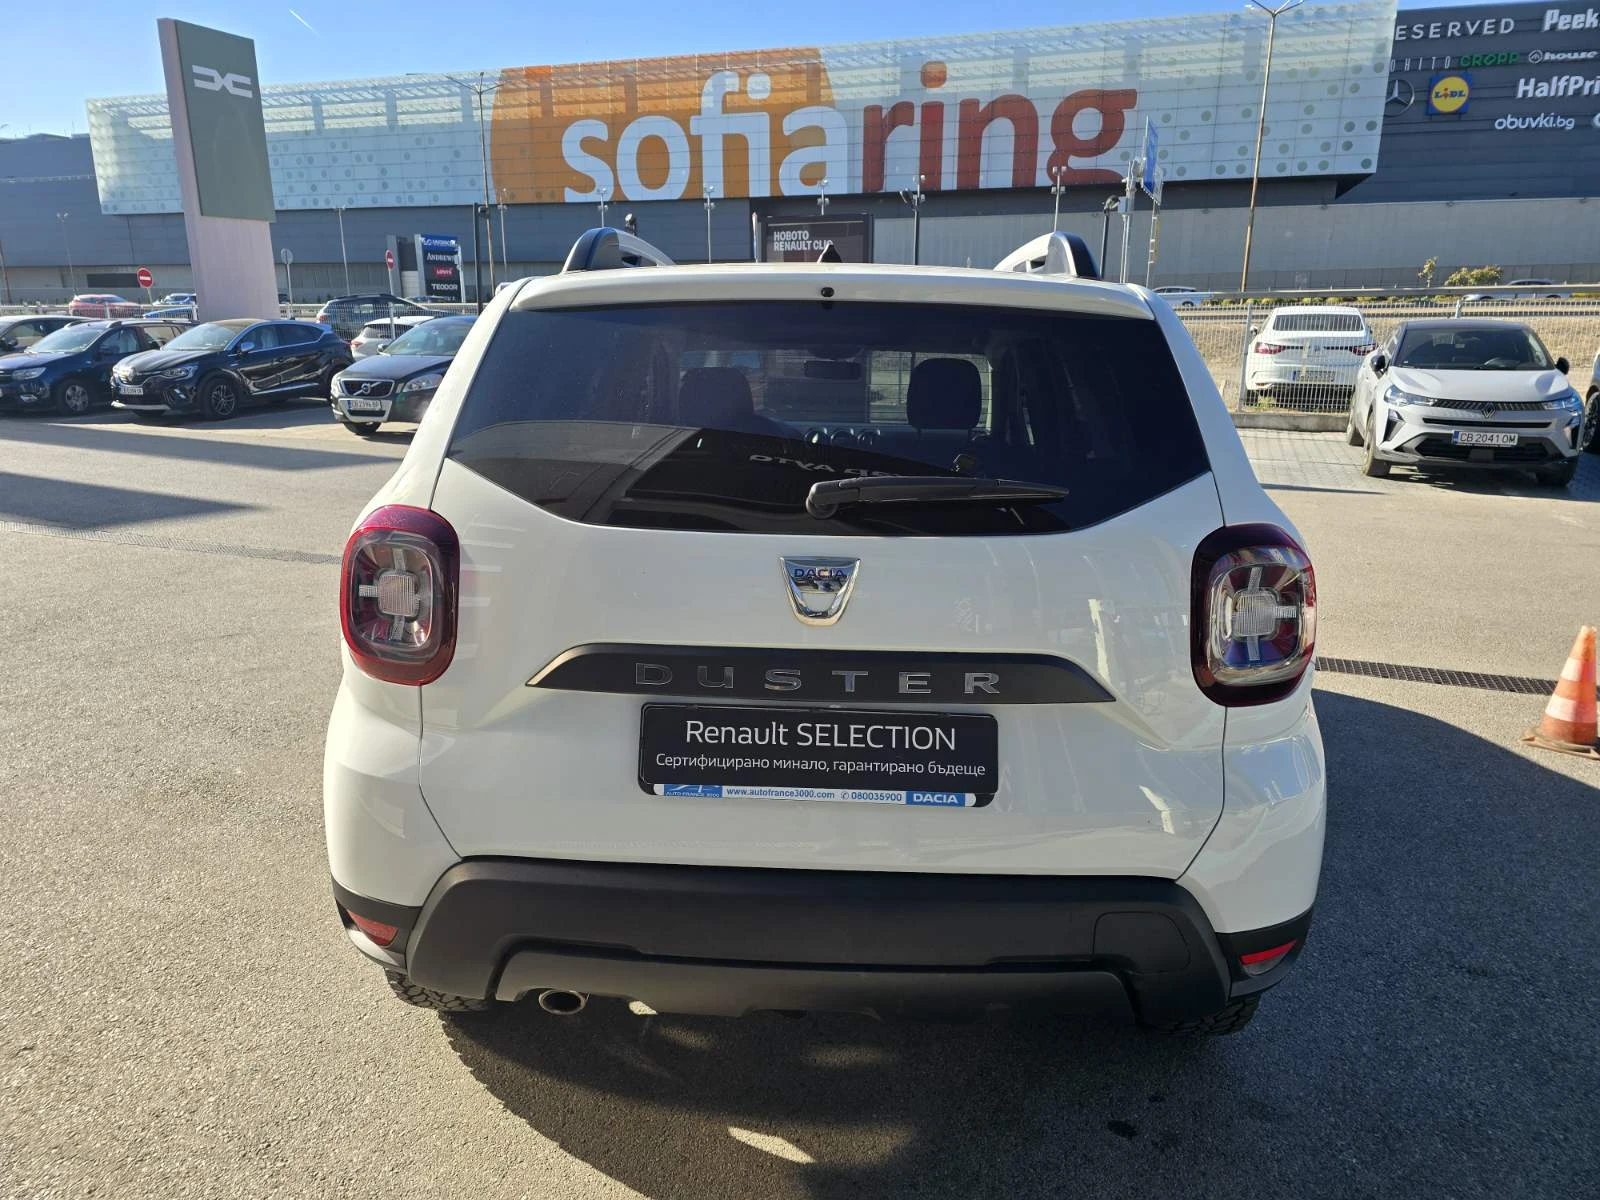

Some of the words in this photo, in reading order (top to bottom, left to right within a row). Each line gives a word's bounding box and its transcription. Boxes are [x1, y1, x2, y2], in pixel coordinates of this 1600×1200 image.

[1542, 8, 1600, 32] Peek
[1460, 52, 1520, 68] CROPP
[1543, 50, 1598, 61] house
[1494, 112, 1575, 130] obuvki.bg
[773, 240, 812, 252] RENAULT
[1475, 433, 1500, 444] 2041
[794, 568, 847, 577] DACIA
[634, 662, 1001, 695] DUSTER
[685, 720, 789, 746] Renault
[796, 723, 956, 750] SELECTION
[655, 753, 770, 770] Сертифицирано
[773, 758, 830, 772] минало,
[833, 761, 924, 777] гарантирано
[929, 762, 986, 777] бъдеще
[726, 787, 835, 799] www.autofrance3000.com
[851, 792, 902, 802] 080035900
[913, 793, 959, 804] DACIA
